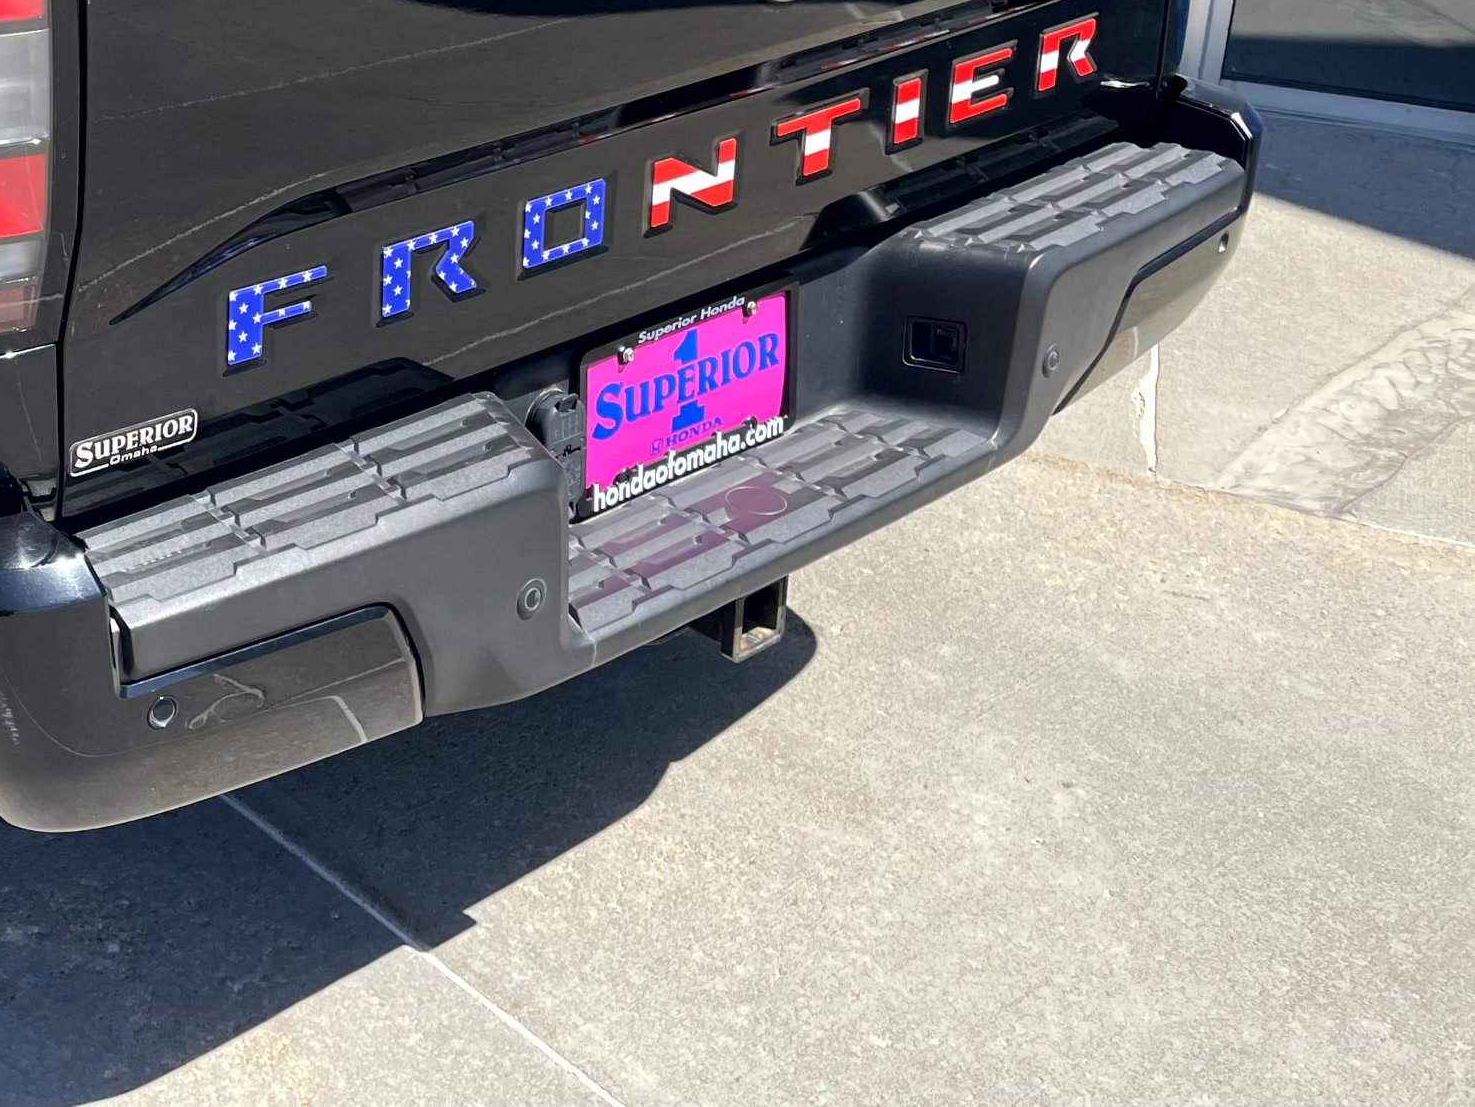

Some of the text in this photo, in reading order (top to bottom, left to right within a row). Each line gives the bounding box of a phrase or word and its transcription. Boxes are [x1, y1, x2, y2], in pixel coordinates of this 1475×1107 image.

[227, 16, 1098, 366] FRONTIER
[637, 296, 746, 344] Superior Honda
[591, 332, 781, 441] SUPERIOR
[74, 414, 193, 469] SUPERIOR
[109, 444, 159, 466] Omaha
[665, 415, 724, 447] HONDA
[592, 414, 786, 513] hondaofomaha.com
